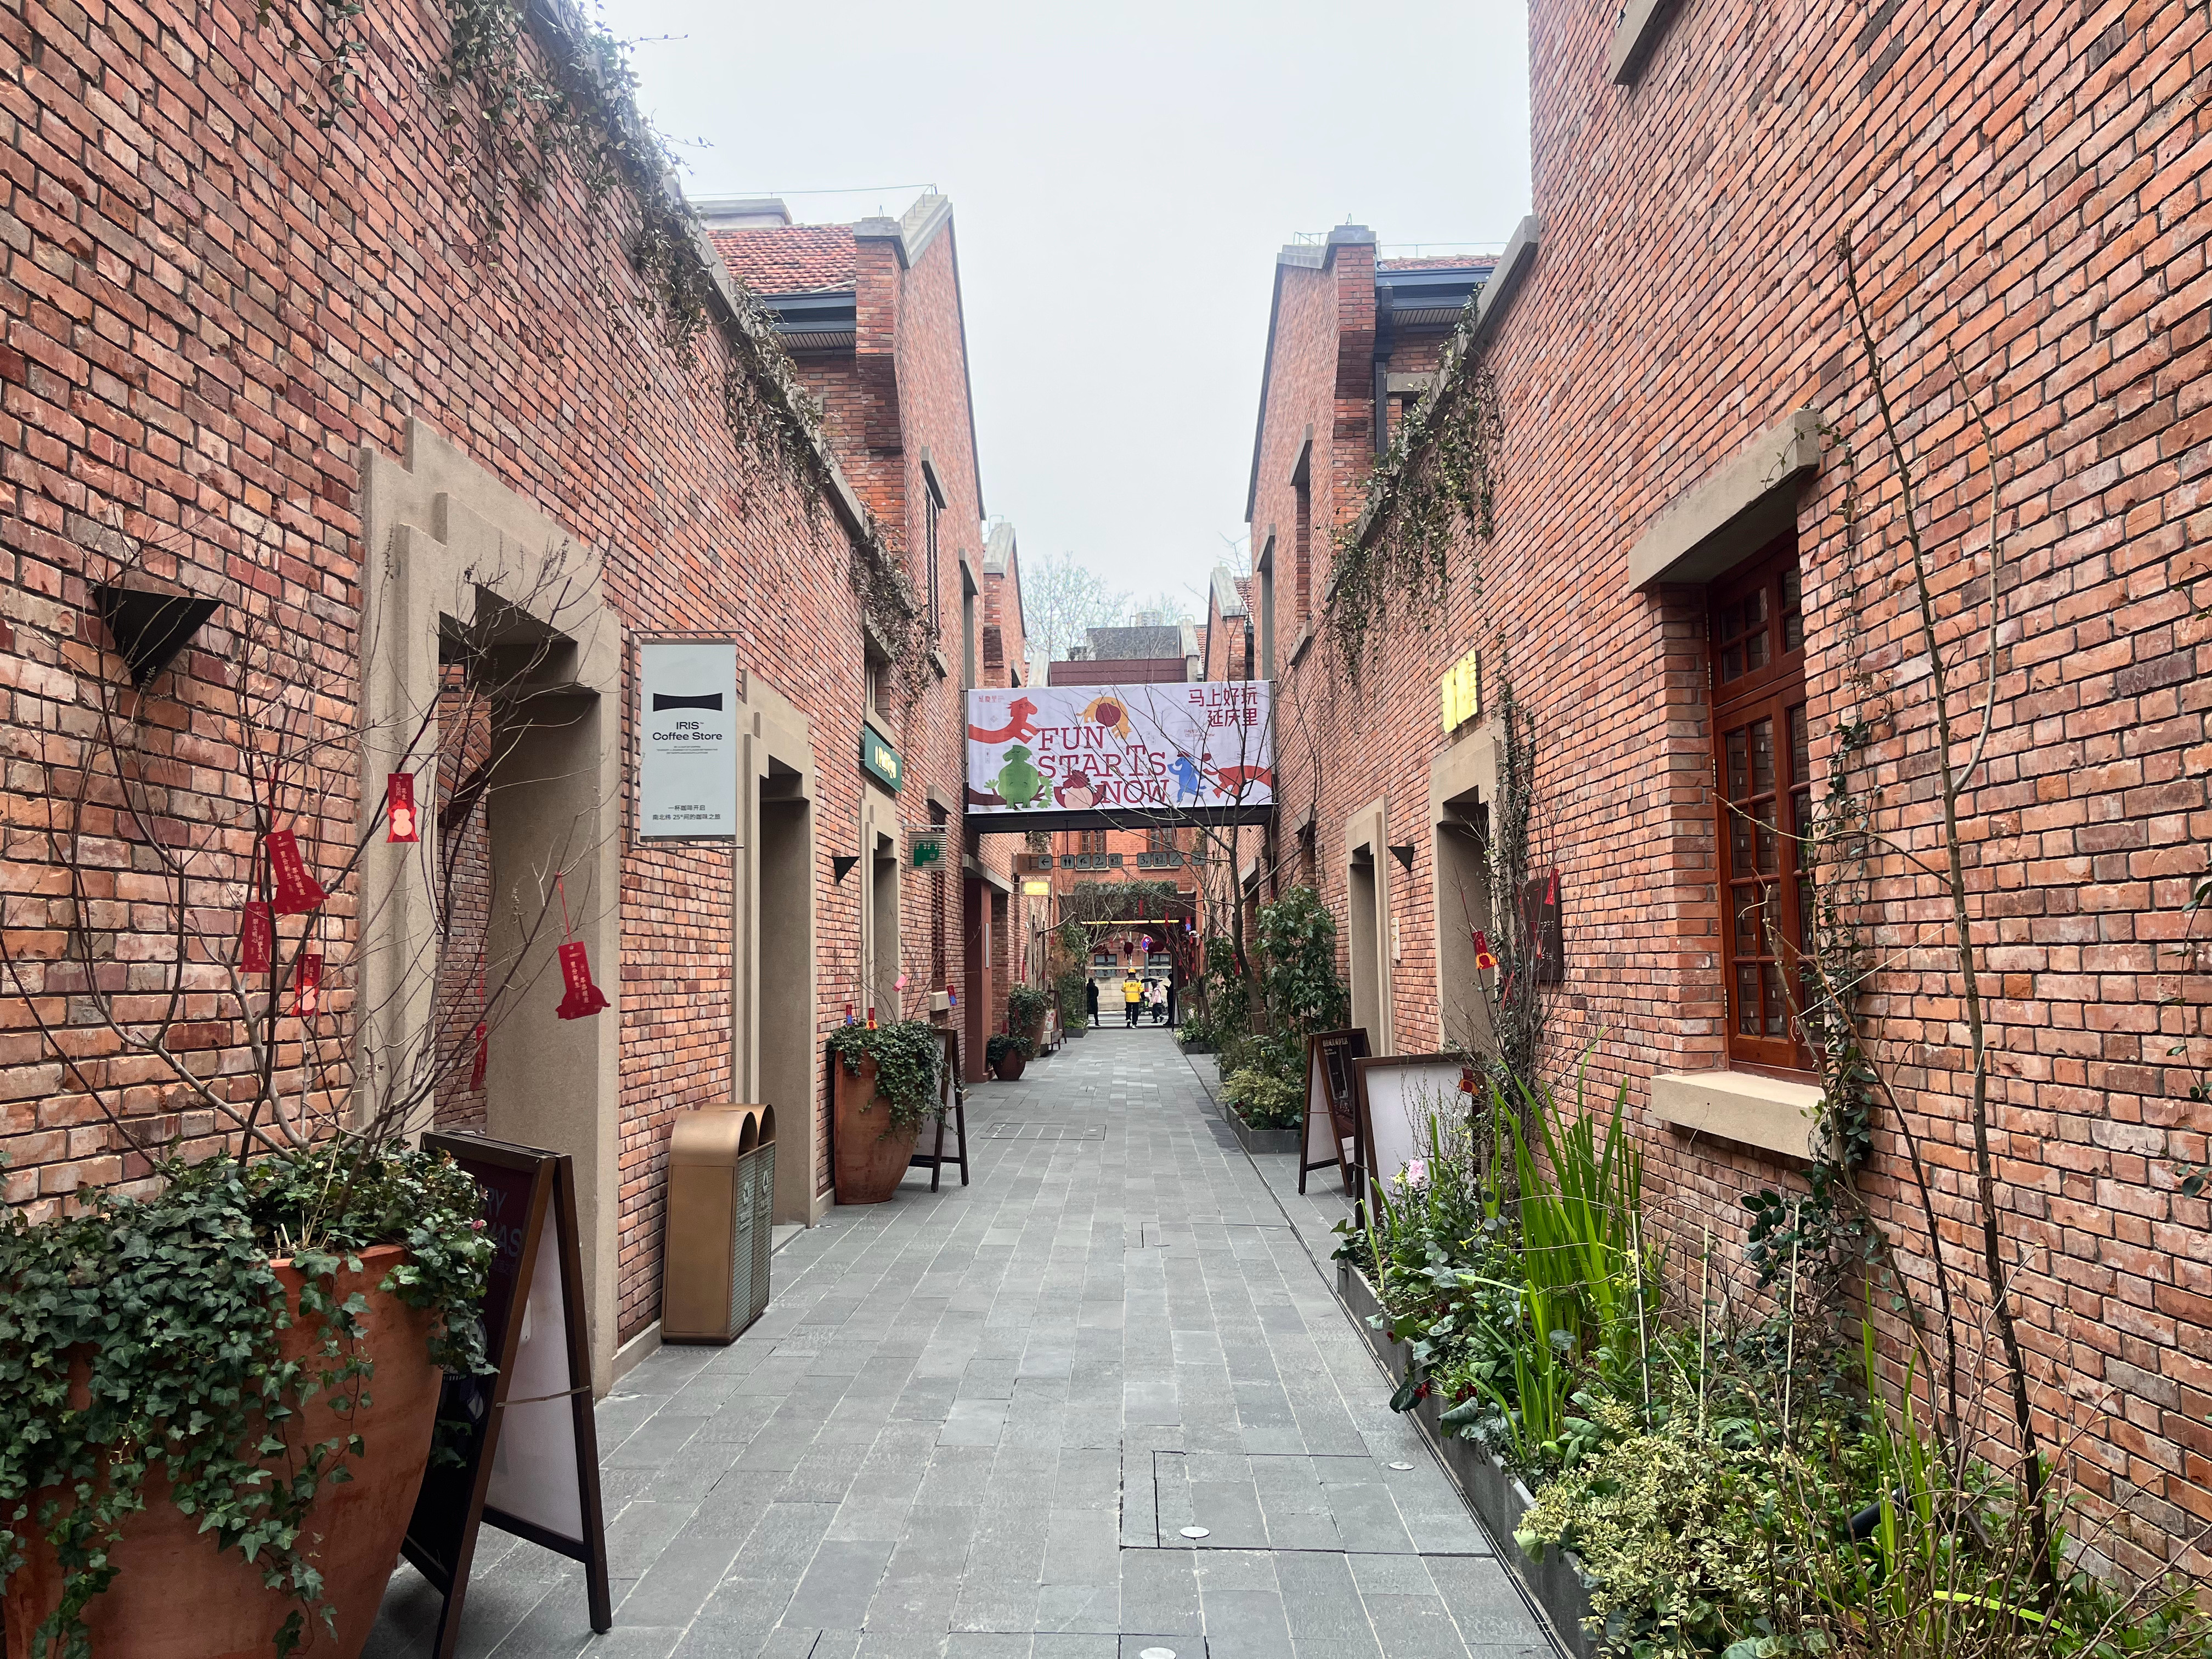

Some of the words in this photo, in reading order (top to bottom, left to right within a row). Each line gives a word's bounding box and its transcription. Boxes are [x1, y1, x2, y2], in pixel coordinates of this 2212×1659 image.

[1188, 687, 1258, 707] 马上好玩
[1207, 708, 1258, 727] 延庆里
[652, 732, 689, 741] Coffee
[692, 732, 723, 740] Store
[1039, 726, 1105, 751] FUN
[1039, 745, 1166, 778] STARTS
[1101, 779, 1169, 804] NOW
